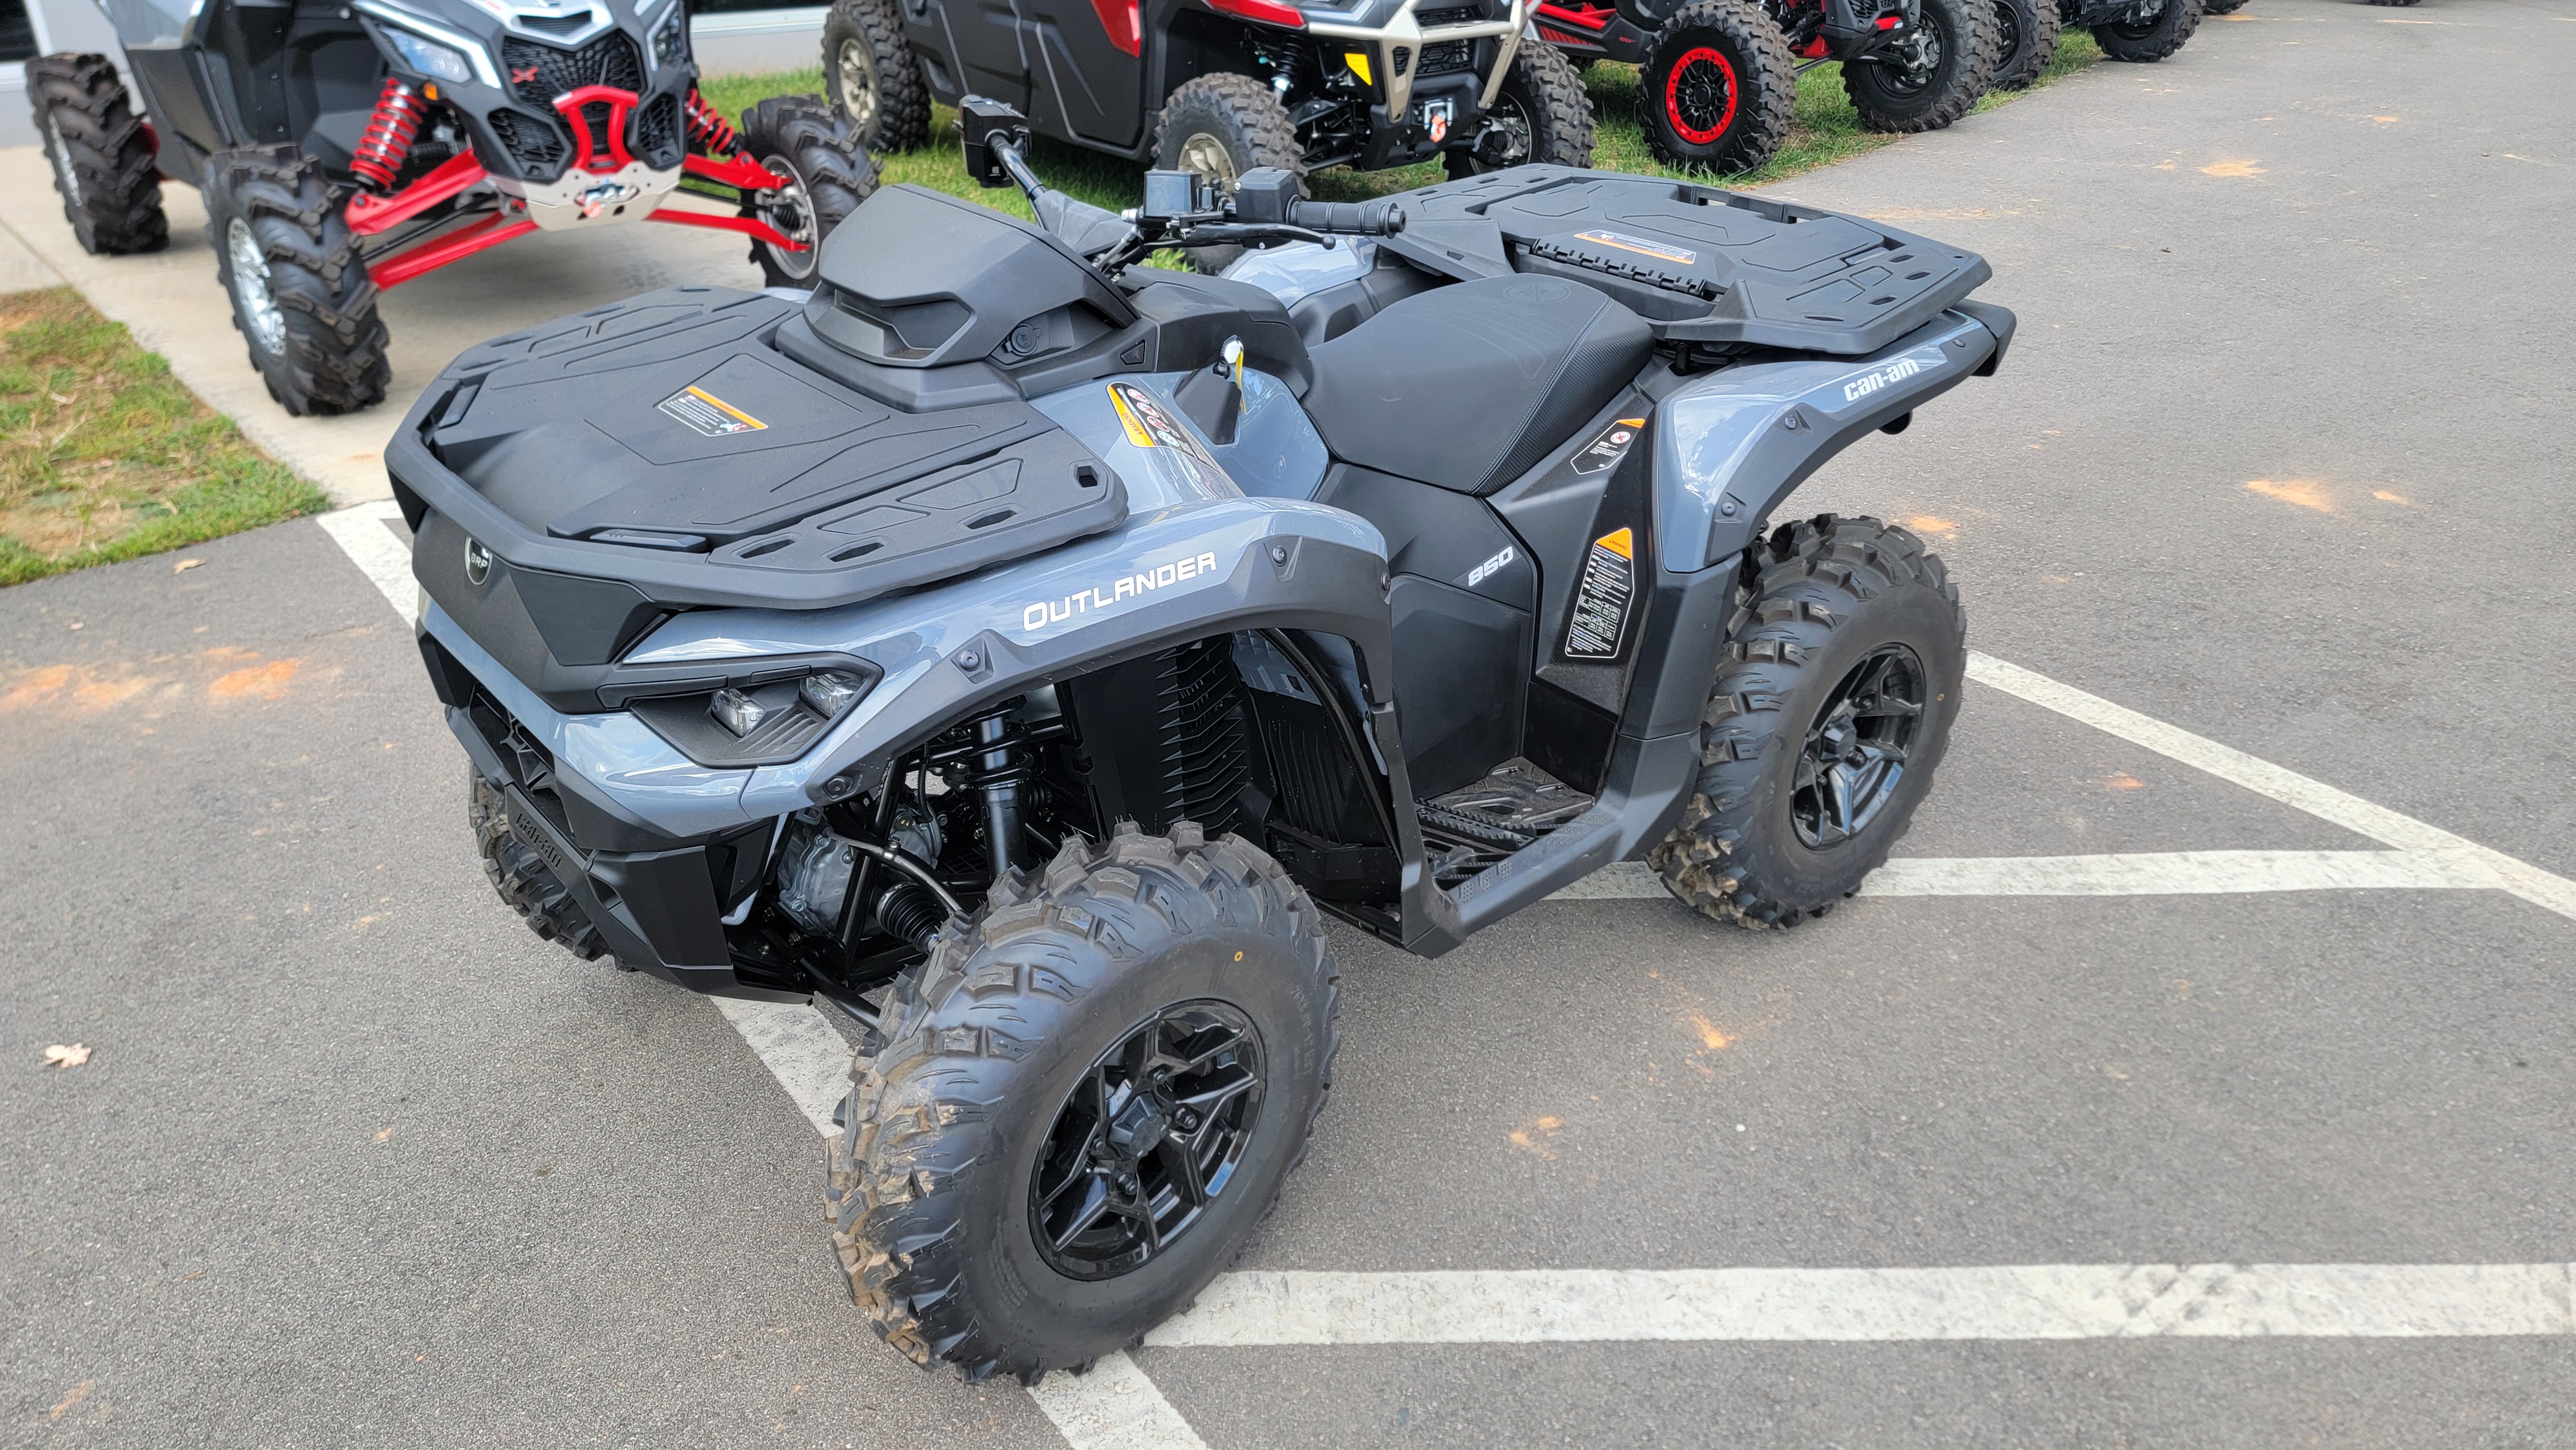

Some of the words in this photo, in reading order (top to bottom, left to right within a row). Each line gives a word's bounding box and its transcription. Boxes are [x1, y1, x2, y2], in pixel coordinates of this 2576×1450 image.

[1843, 359, 1920, 402] can-am
[470, 552, 488, 569] BRP
[1468, 546, 1513, 587] 850
[1023, 551, 1217, 632] OUTLANDER
